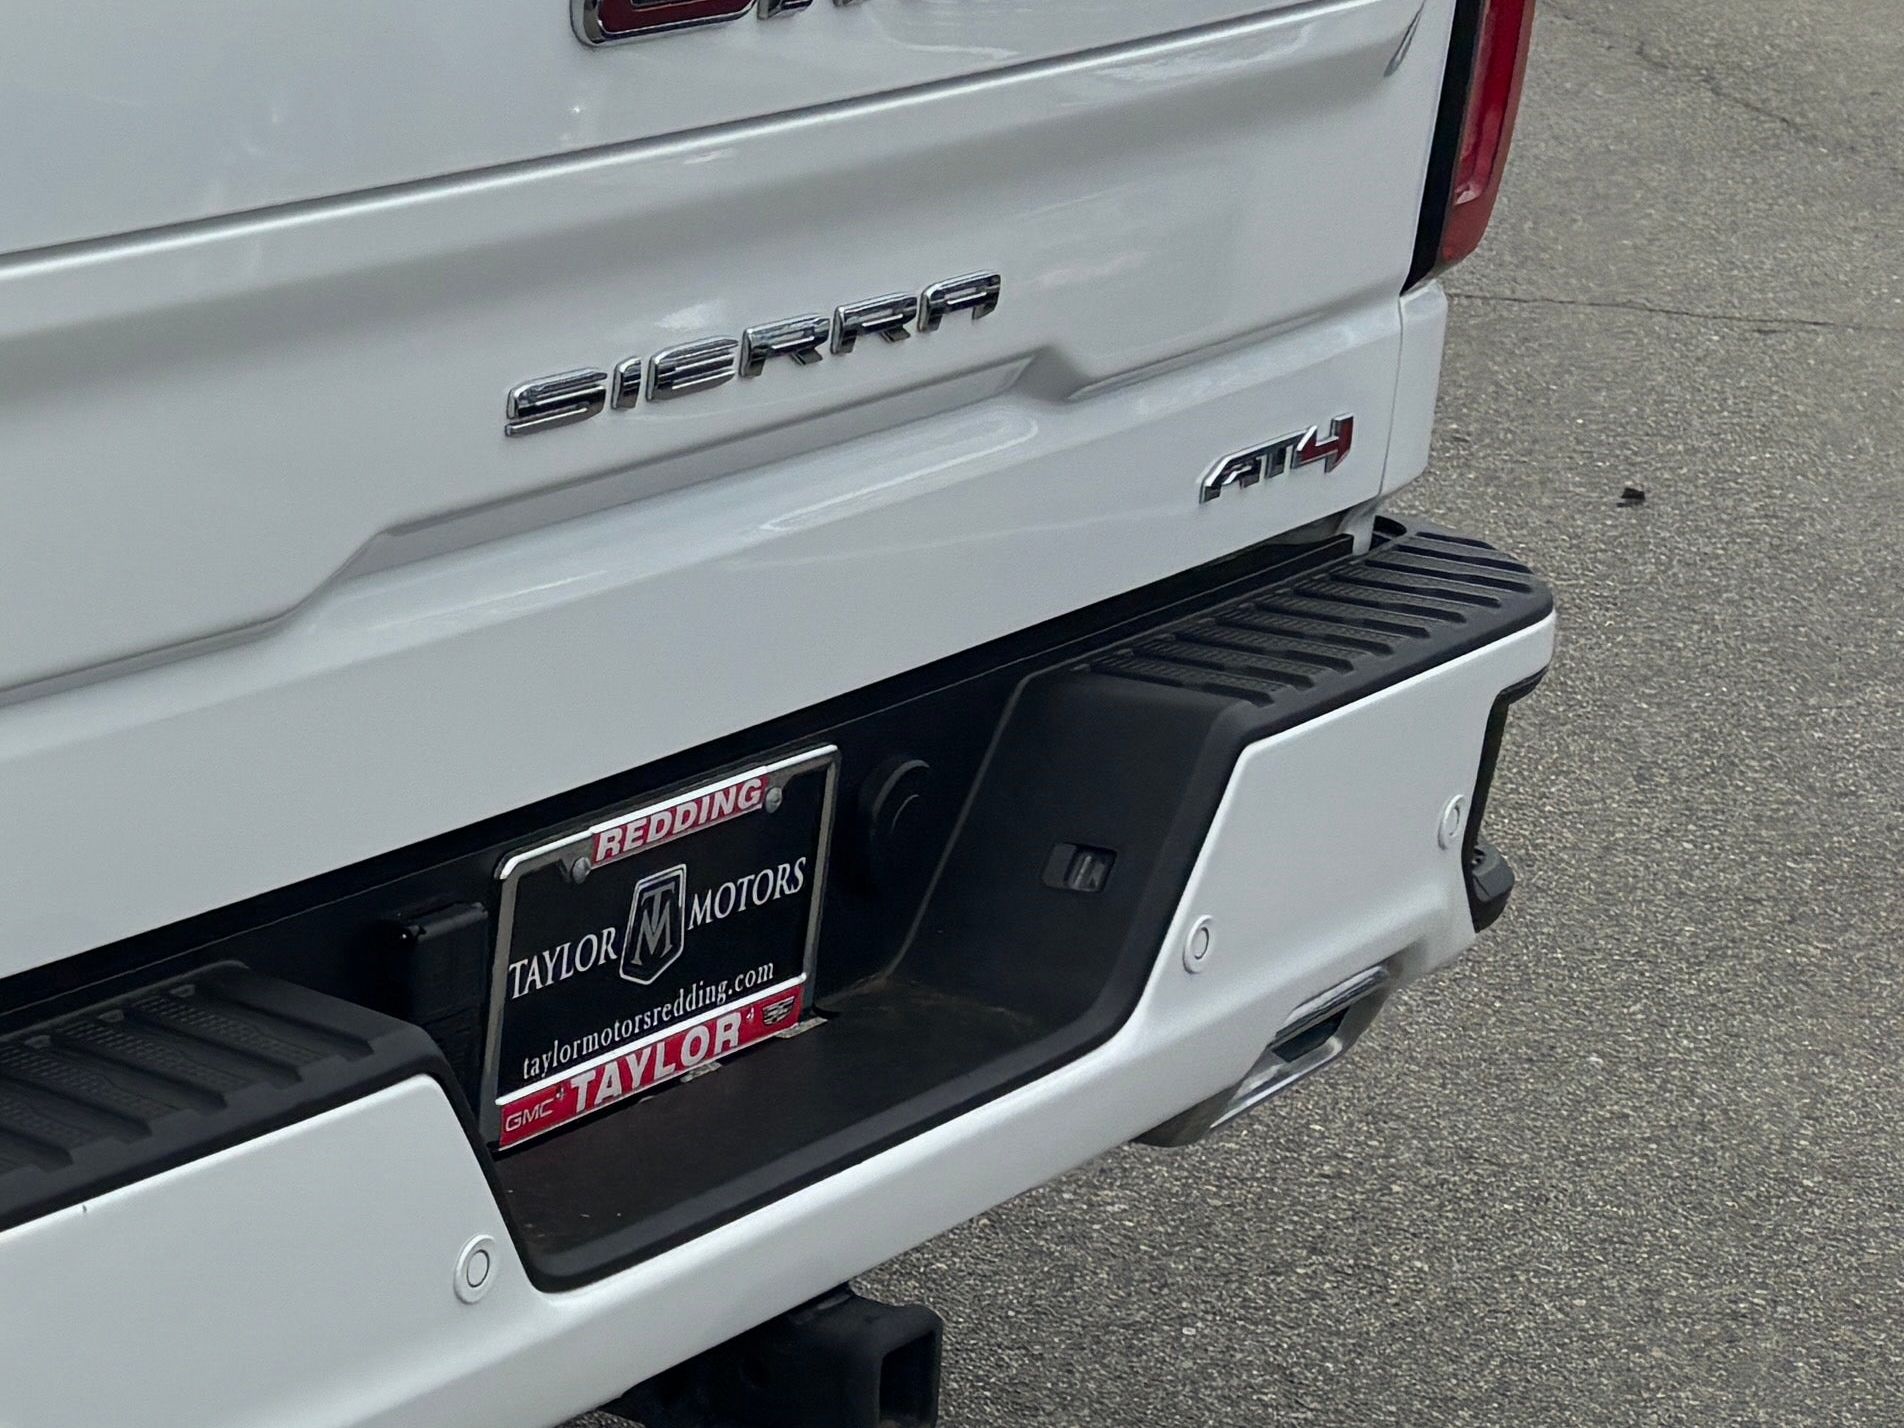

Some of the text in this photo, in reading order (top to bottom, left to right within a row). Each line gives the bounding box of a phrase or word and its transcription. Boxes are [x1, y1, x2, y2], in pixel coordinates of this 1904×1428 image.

[503, 268, 1002, 439] SIERRA
[1197, 413, 1355, 504] AT4
[594, 778, 763, 862] REDDING
[508, 857, 807, 1000] TAYLOR MOTORS
[504, 1011, 742, 1133] GMC TAYLOR
[522, 962, 775, 1080] taylormotorsredding.com
